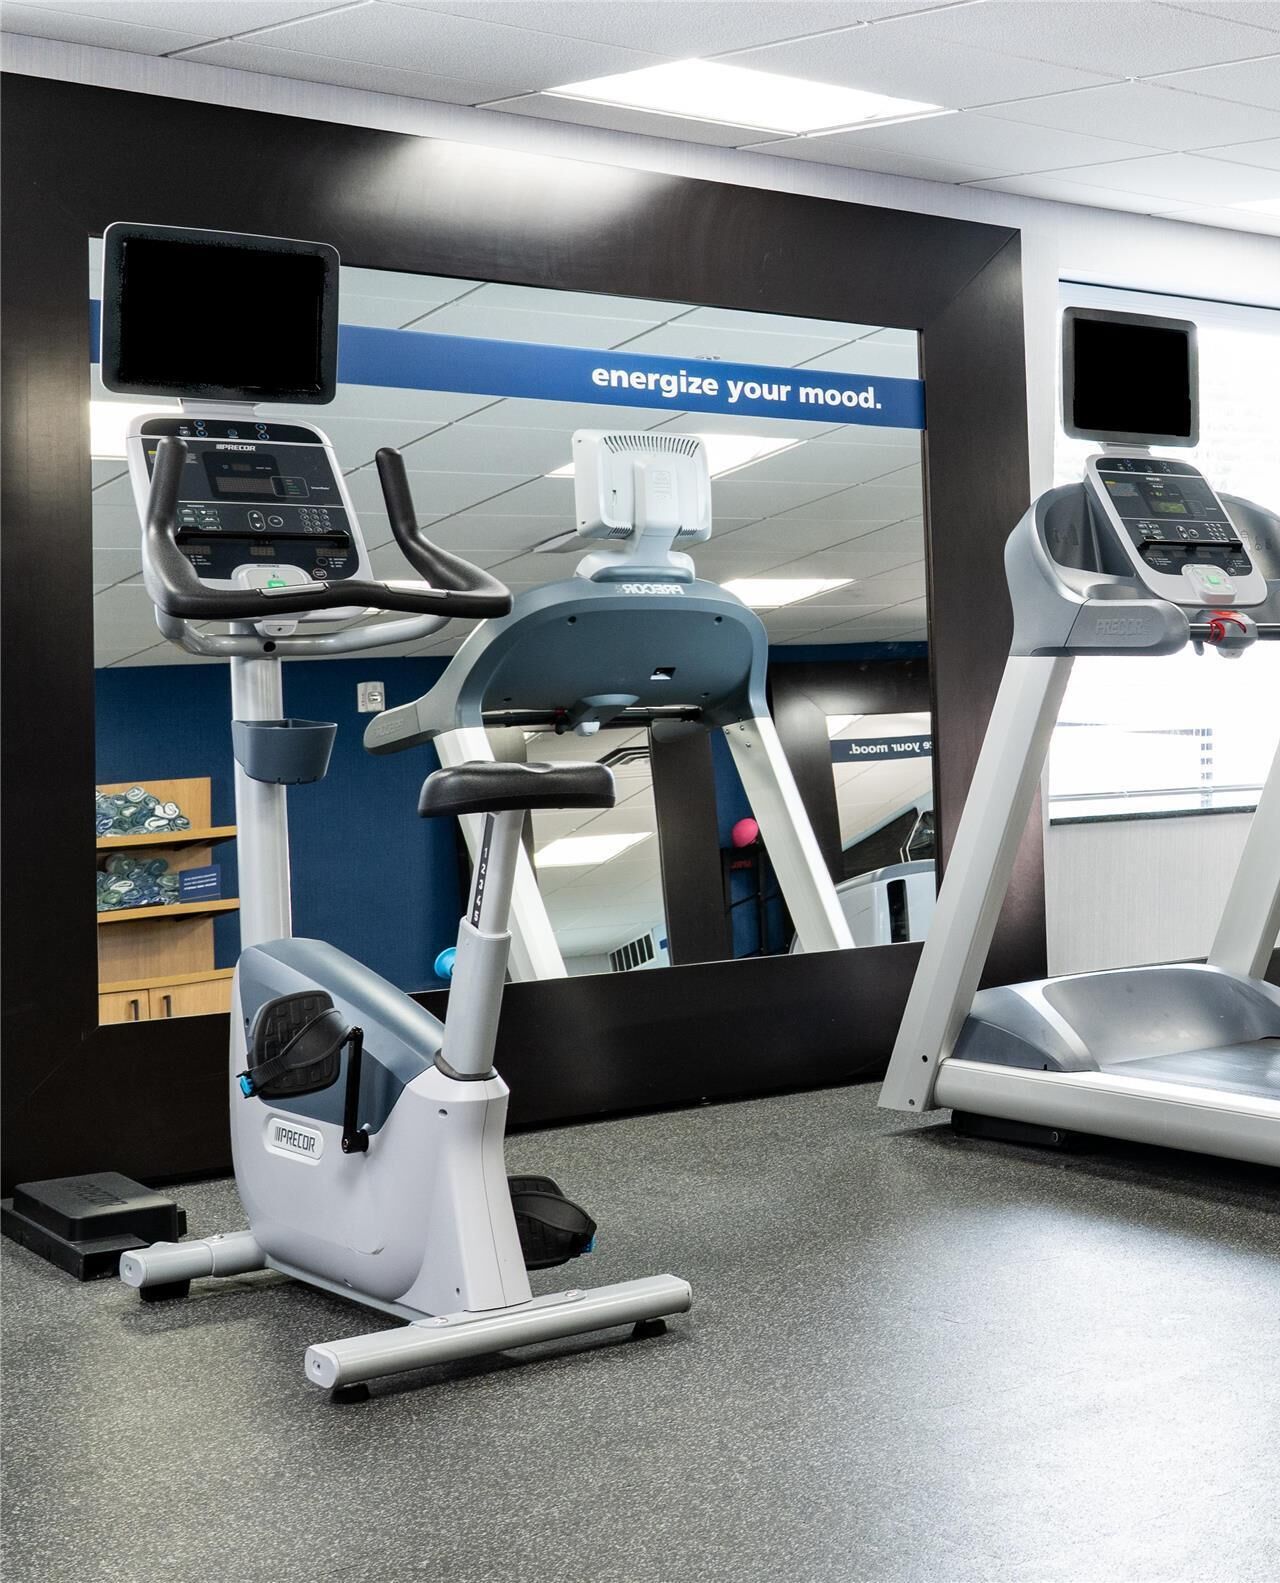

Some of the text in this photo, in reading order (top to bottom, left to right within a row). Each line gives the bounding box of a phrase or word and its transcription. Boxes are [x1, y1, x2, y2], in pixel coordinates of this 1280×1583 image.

[591, 366, 882, 409] energize your mood.
[222, 443, 256, 452] PRECOR
[473, 847, 489, 922] 1 2 3 4 5
[278, 1126, 316, 1153] PRECOR
